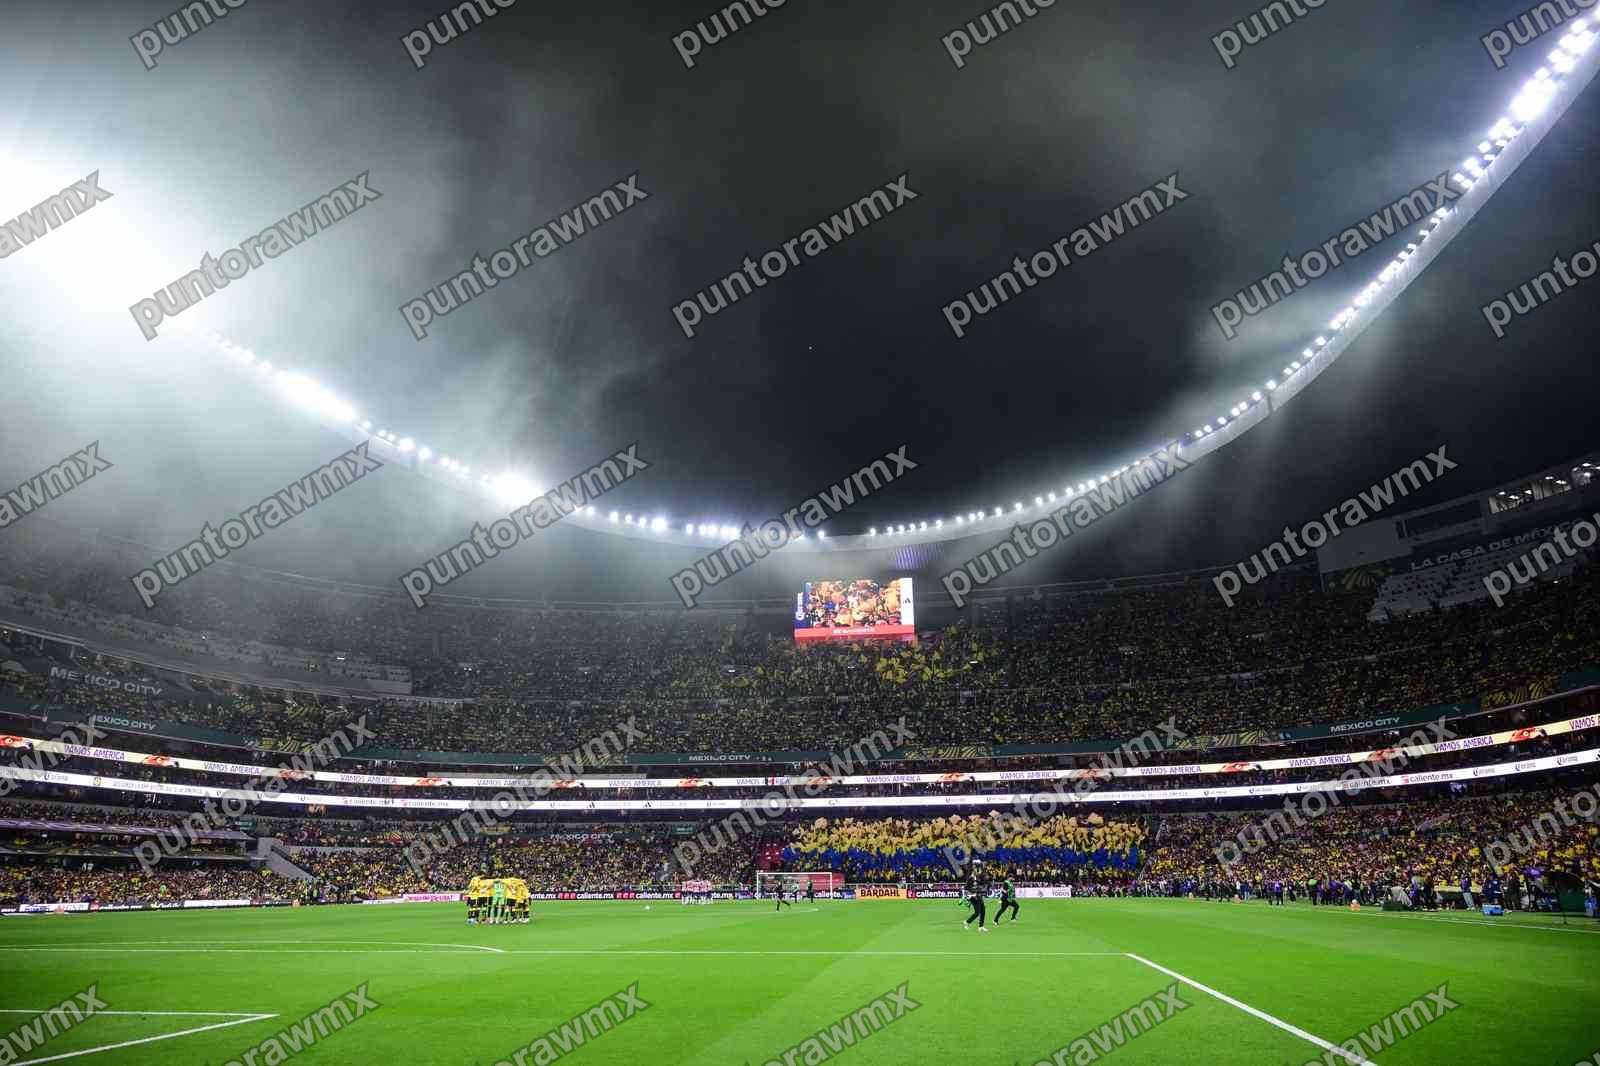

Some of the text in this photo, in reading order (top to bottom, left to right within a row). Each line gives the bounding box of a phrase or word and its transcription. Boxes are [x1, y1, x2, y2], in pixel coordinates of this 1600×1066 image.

[1437, 545, 1485, 564] CASA
[124, 681, 163, 696] CITY
[95, 714, 157, 731] EXICO CITY
[1330, 716, 1400, 733] MEXICO CITY
[1568, 715, 1596, 731] VAMOS
[1434, 735, 1494, 752] VAMOS AMERICA
[728, 753, 751, 761] CITY
[1288, 754, 1352, 767] VAMOS AMERICA
[1000, 771, 1025, 779] VAMOS
[1140, 765, 1202, 775] VAMOS AMERICA
[866, 775, 891, 784] VAMOS
[590, 832, 614, 841] CITY
[576, 891, 614, 899] caliente.mx
[635, 891, 673, 899] caliente.mx
[860, 889, 901, 898] BARDAHL
[915, 889, 960, 899] caliente.mx
